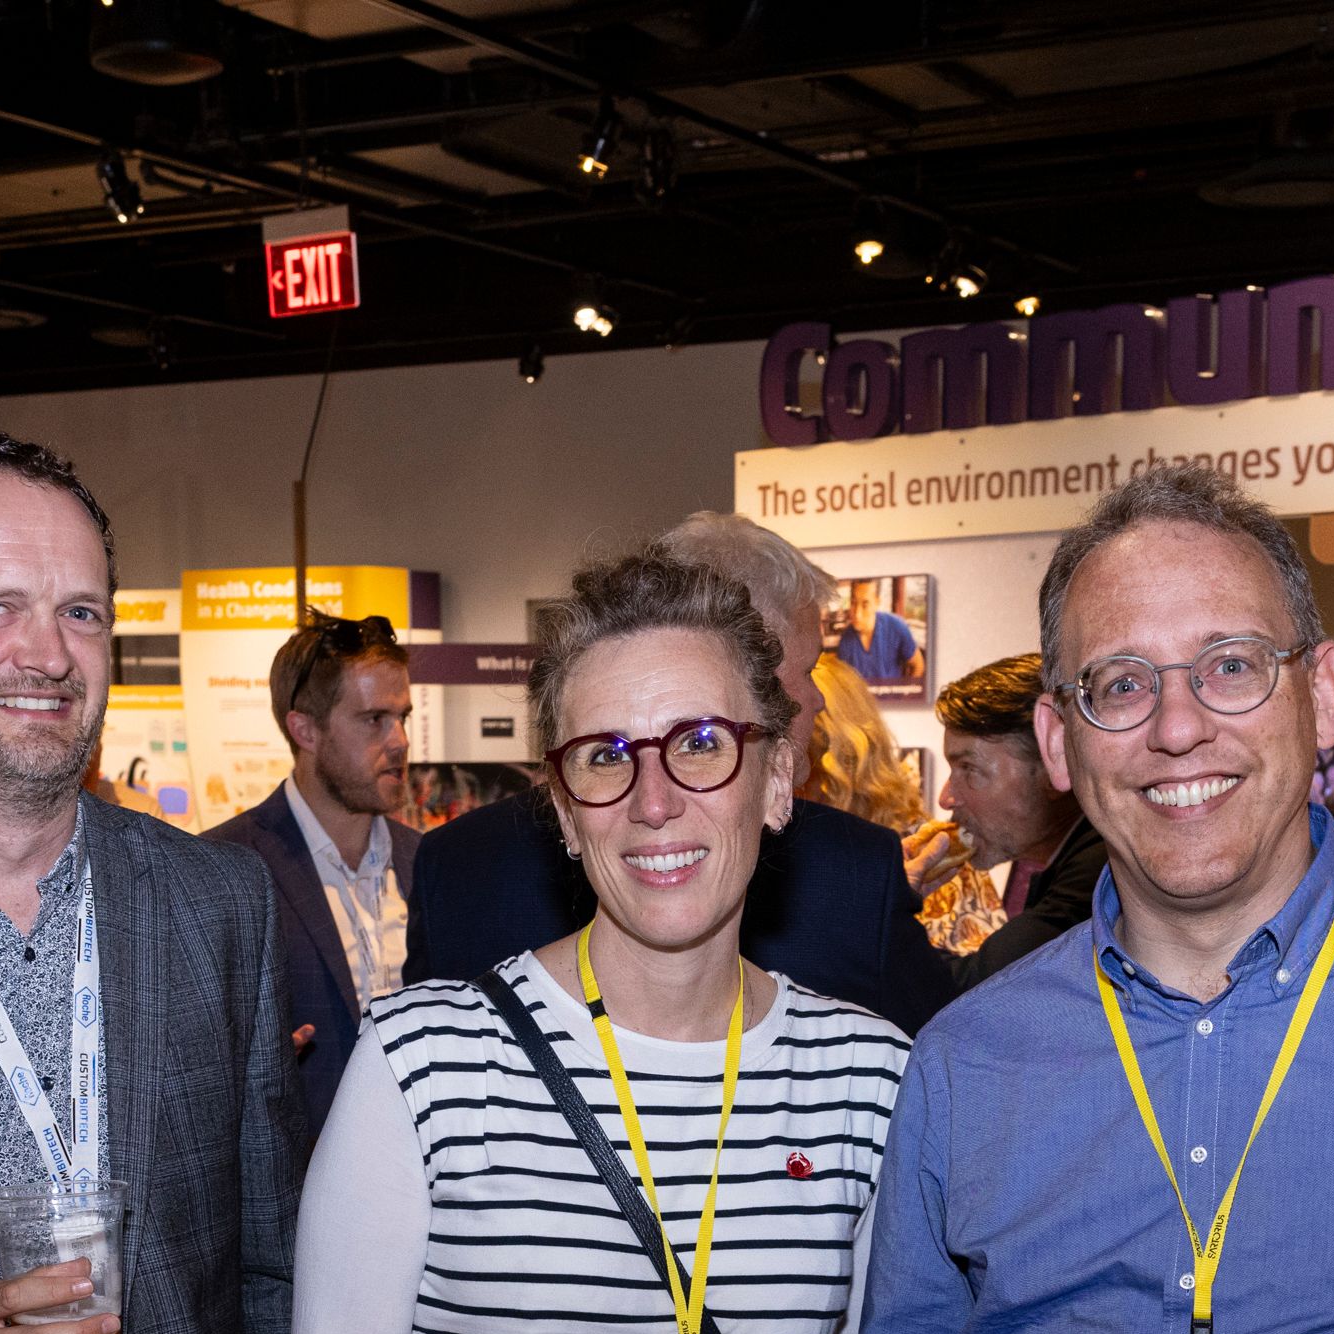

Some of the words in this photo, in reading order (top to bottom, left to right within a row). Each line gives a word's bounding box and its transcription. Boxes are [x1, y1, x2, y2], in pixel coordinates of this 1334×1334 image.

[284, 243, 342, 308] EXIT
[758, 481, 806, 518] The
[815, 471, 897, 514] social
[906, 453, 1120, 507] environment
[1130, 446, 1282, 484] cges
[196, 581, 250, 599] Health
[253, 579, 343, 598] Condions
[197, 602, 212, 618] in
[214, 605, 224, 618] a
[226, 602, 296, 620] Changing
[81, 993, 93, 1022] Roche
[79, 1053, 89, 1144] CUSTOMBIOTECH
[1208, 1214, 1225, 1259] SARTORIUS
